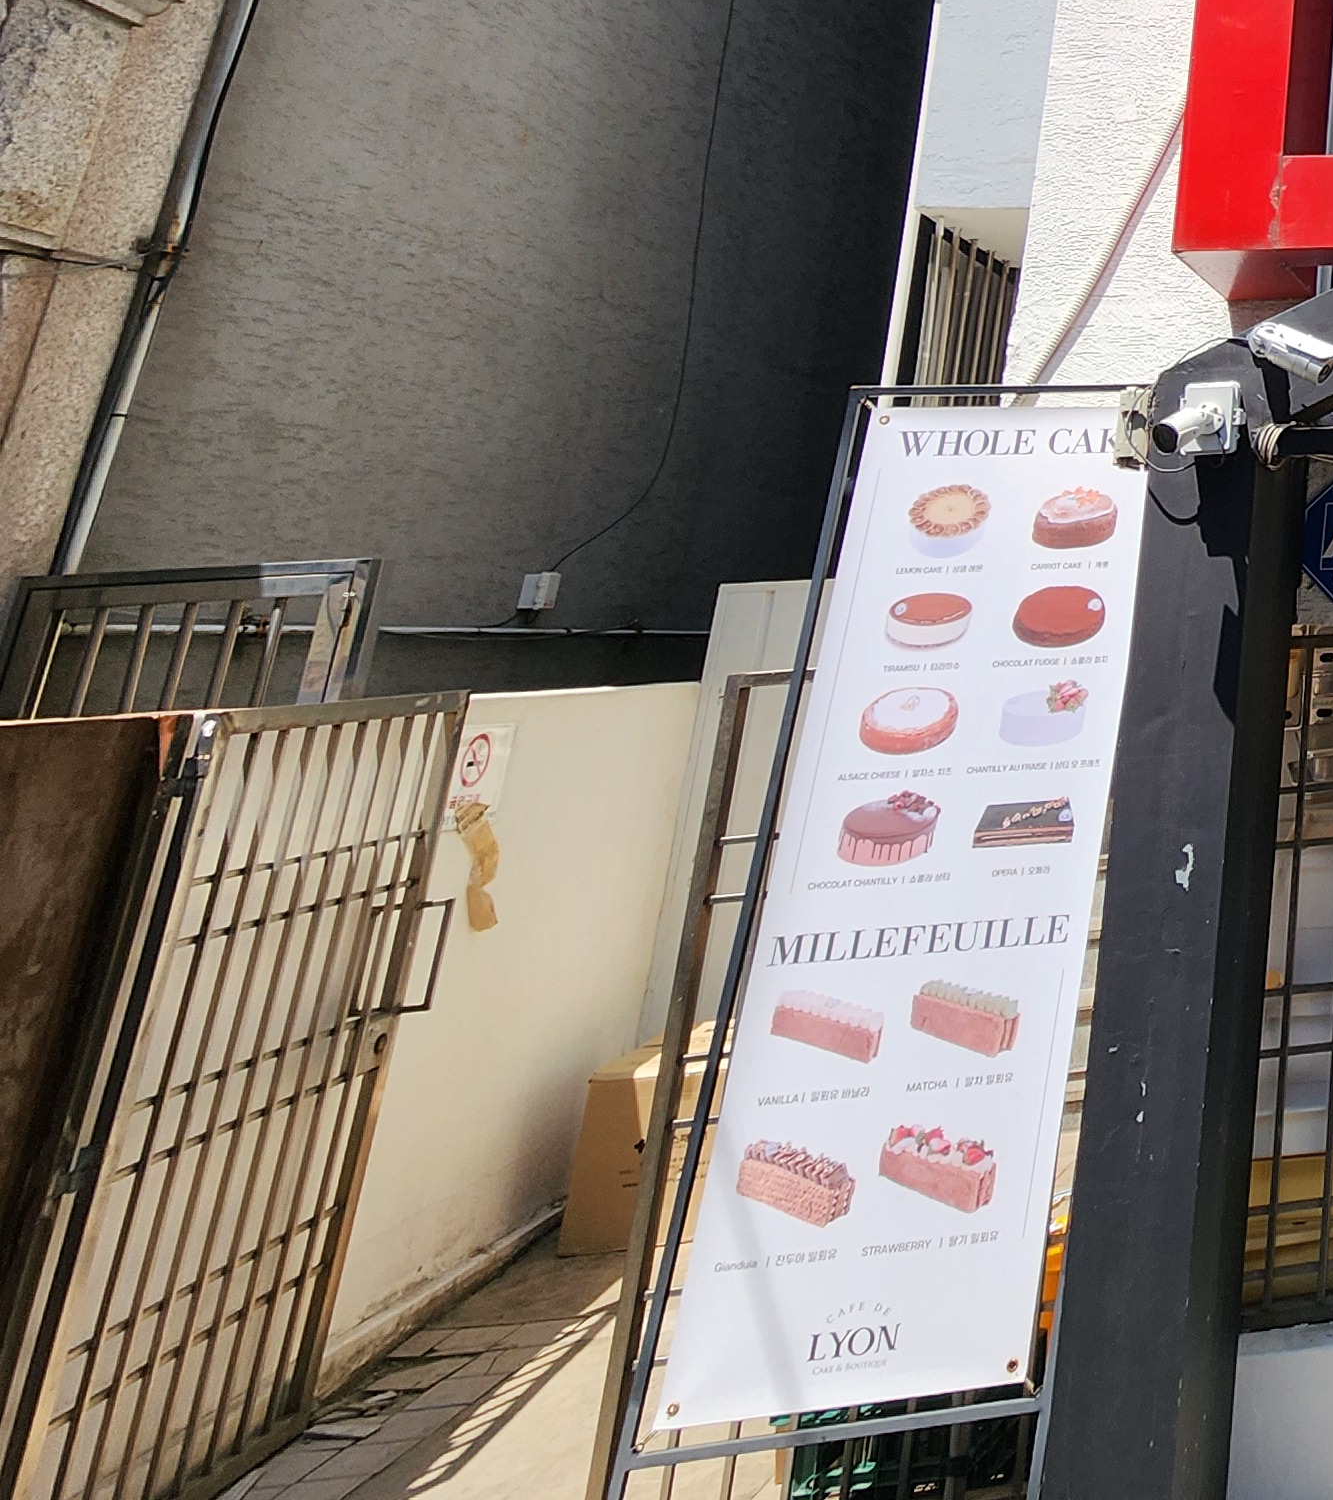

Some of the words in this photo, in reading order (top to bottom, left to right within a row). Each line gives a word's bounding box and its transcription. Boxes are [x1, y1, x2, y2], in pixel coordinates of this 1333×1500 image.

[898, 428, 1037, 458] WHOLE
[1048, 427, 1119, 456] CAK
[895, 566, 922, 575] LEMON
[923, 566, 943, 574] CAKE
[1030, 563, 1061, 571] CARROT
[1062, 562, 1082, 570] CAKE
[883, 663, 920, 673] TIRAMISU
[930, 662, 960, 671] 티라미수
[992, 658, 1033, 669] CHOCOLAT
[1034, 658, 1060, 667] FUDGE
[966, 764, 1008, 774] CHANTILLY
[1008, 763, 1021, 772] AU
[1021, 762, 1047, 771] FRAISE
[1071, 760, 1078, 769] 오
[837, 771, 869, 782] ALSACE
[870, 770, 901, 780] CHEESE
[937, 767, 952, 776] 치즈
[991, 868, 1018, 878] OPERA
[807, 879, 852, 891] CHOCOLAT
[853, 877, 898, 887] CHANTILLY
[767, 914, 1071, 968] MILLEFEUILLE
[905, 1079, 948, 1093] MATCHA
[964, 1075, 984, 1088] 말차
[758, 1094, 800, 1107] VANILLA
[861, 1239, 932, 1258] STRAWBERRY
[948, 1233, 968, 1248] 딸기
[825, 1301, 866, 1324] CAFE
[873, 1302, 892, 1317] DE
[806, 1323, 902, 1363] LYON
